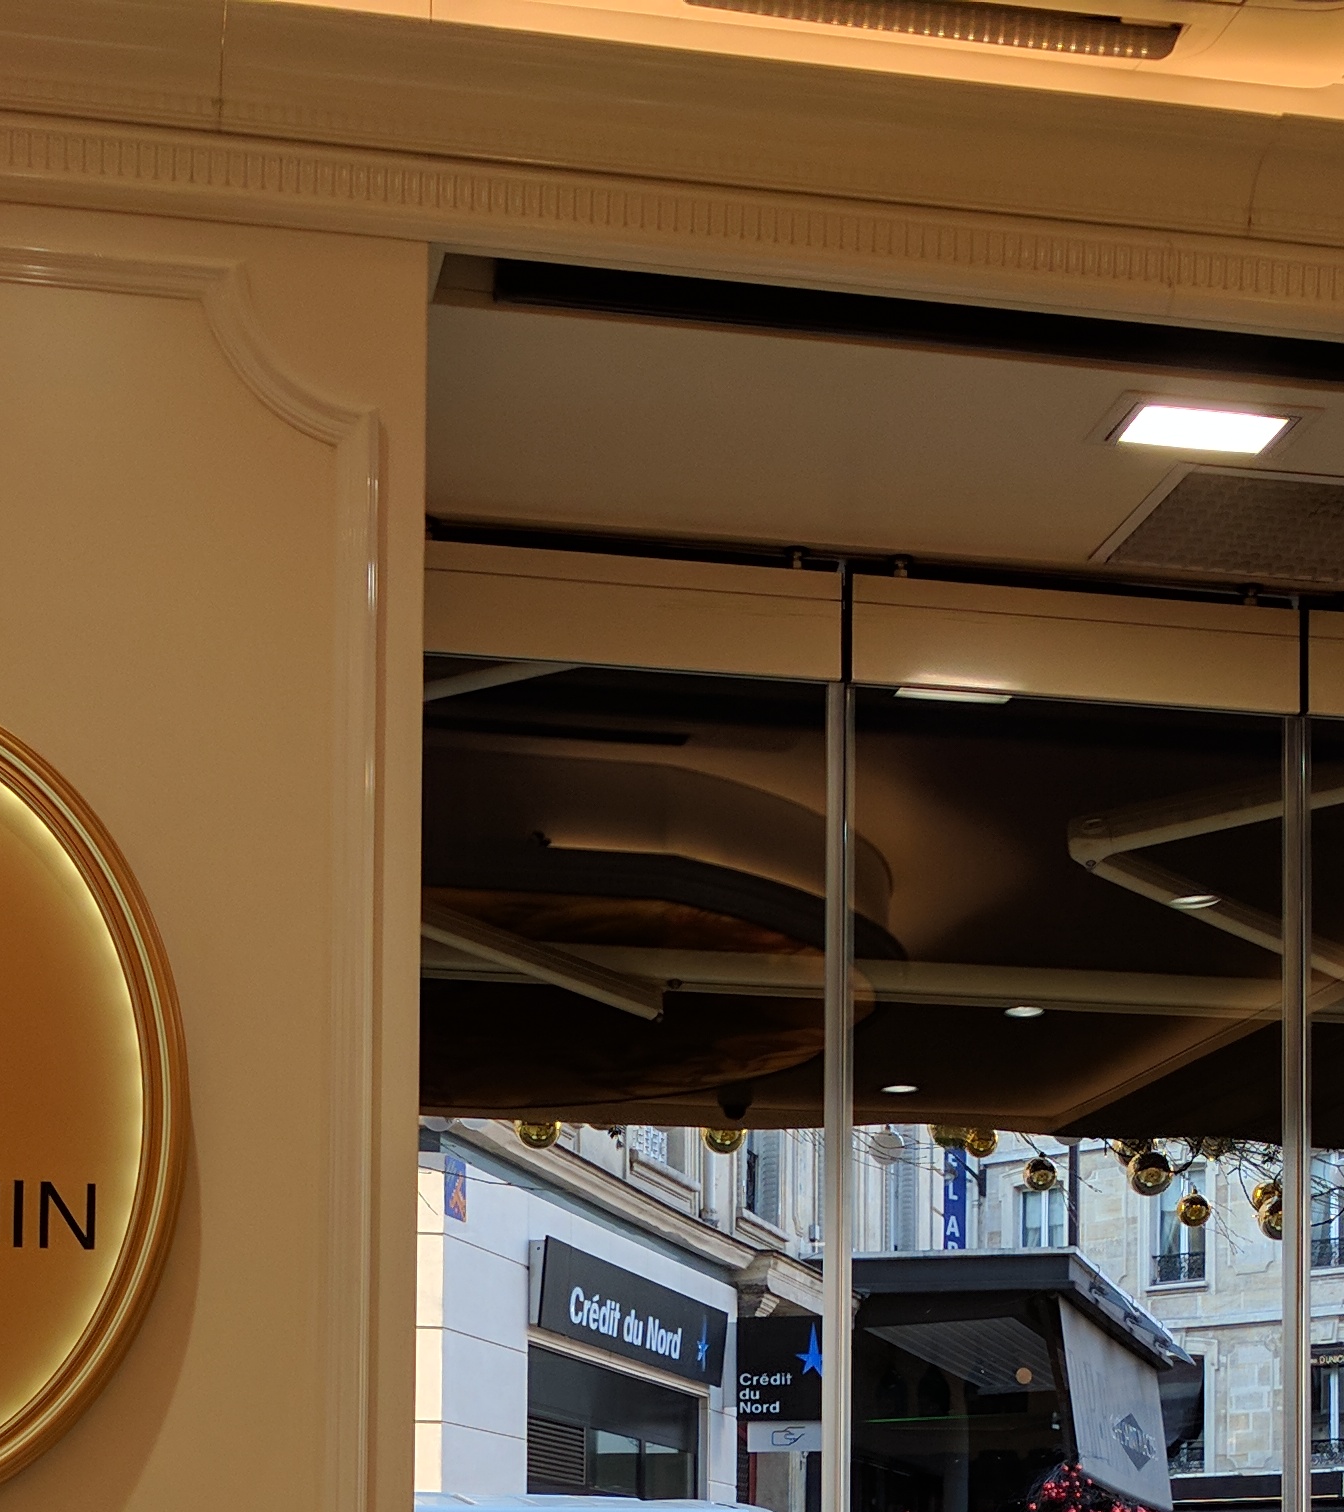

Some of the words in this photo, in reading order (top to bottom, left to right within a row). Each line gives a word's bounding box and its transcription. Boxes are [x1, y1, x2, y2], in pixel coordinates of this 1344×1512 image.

[569, 1286, 621, 1338] Crédit
[623, 1309, 644, 1346] du
[645, 1316, 682, 1360] Nord
[739, 1372, 792, 1386] Crédit
[739, 1387, 760, 1400] du
[739, 1401, 781, 1414] Nord
